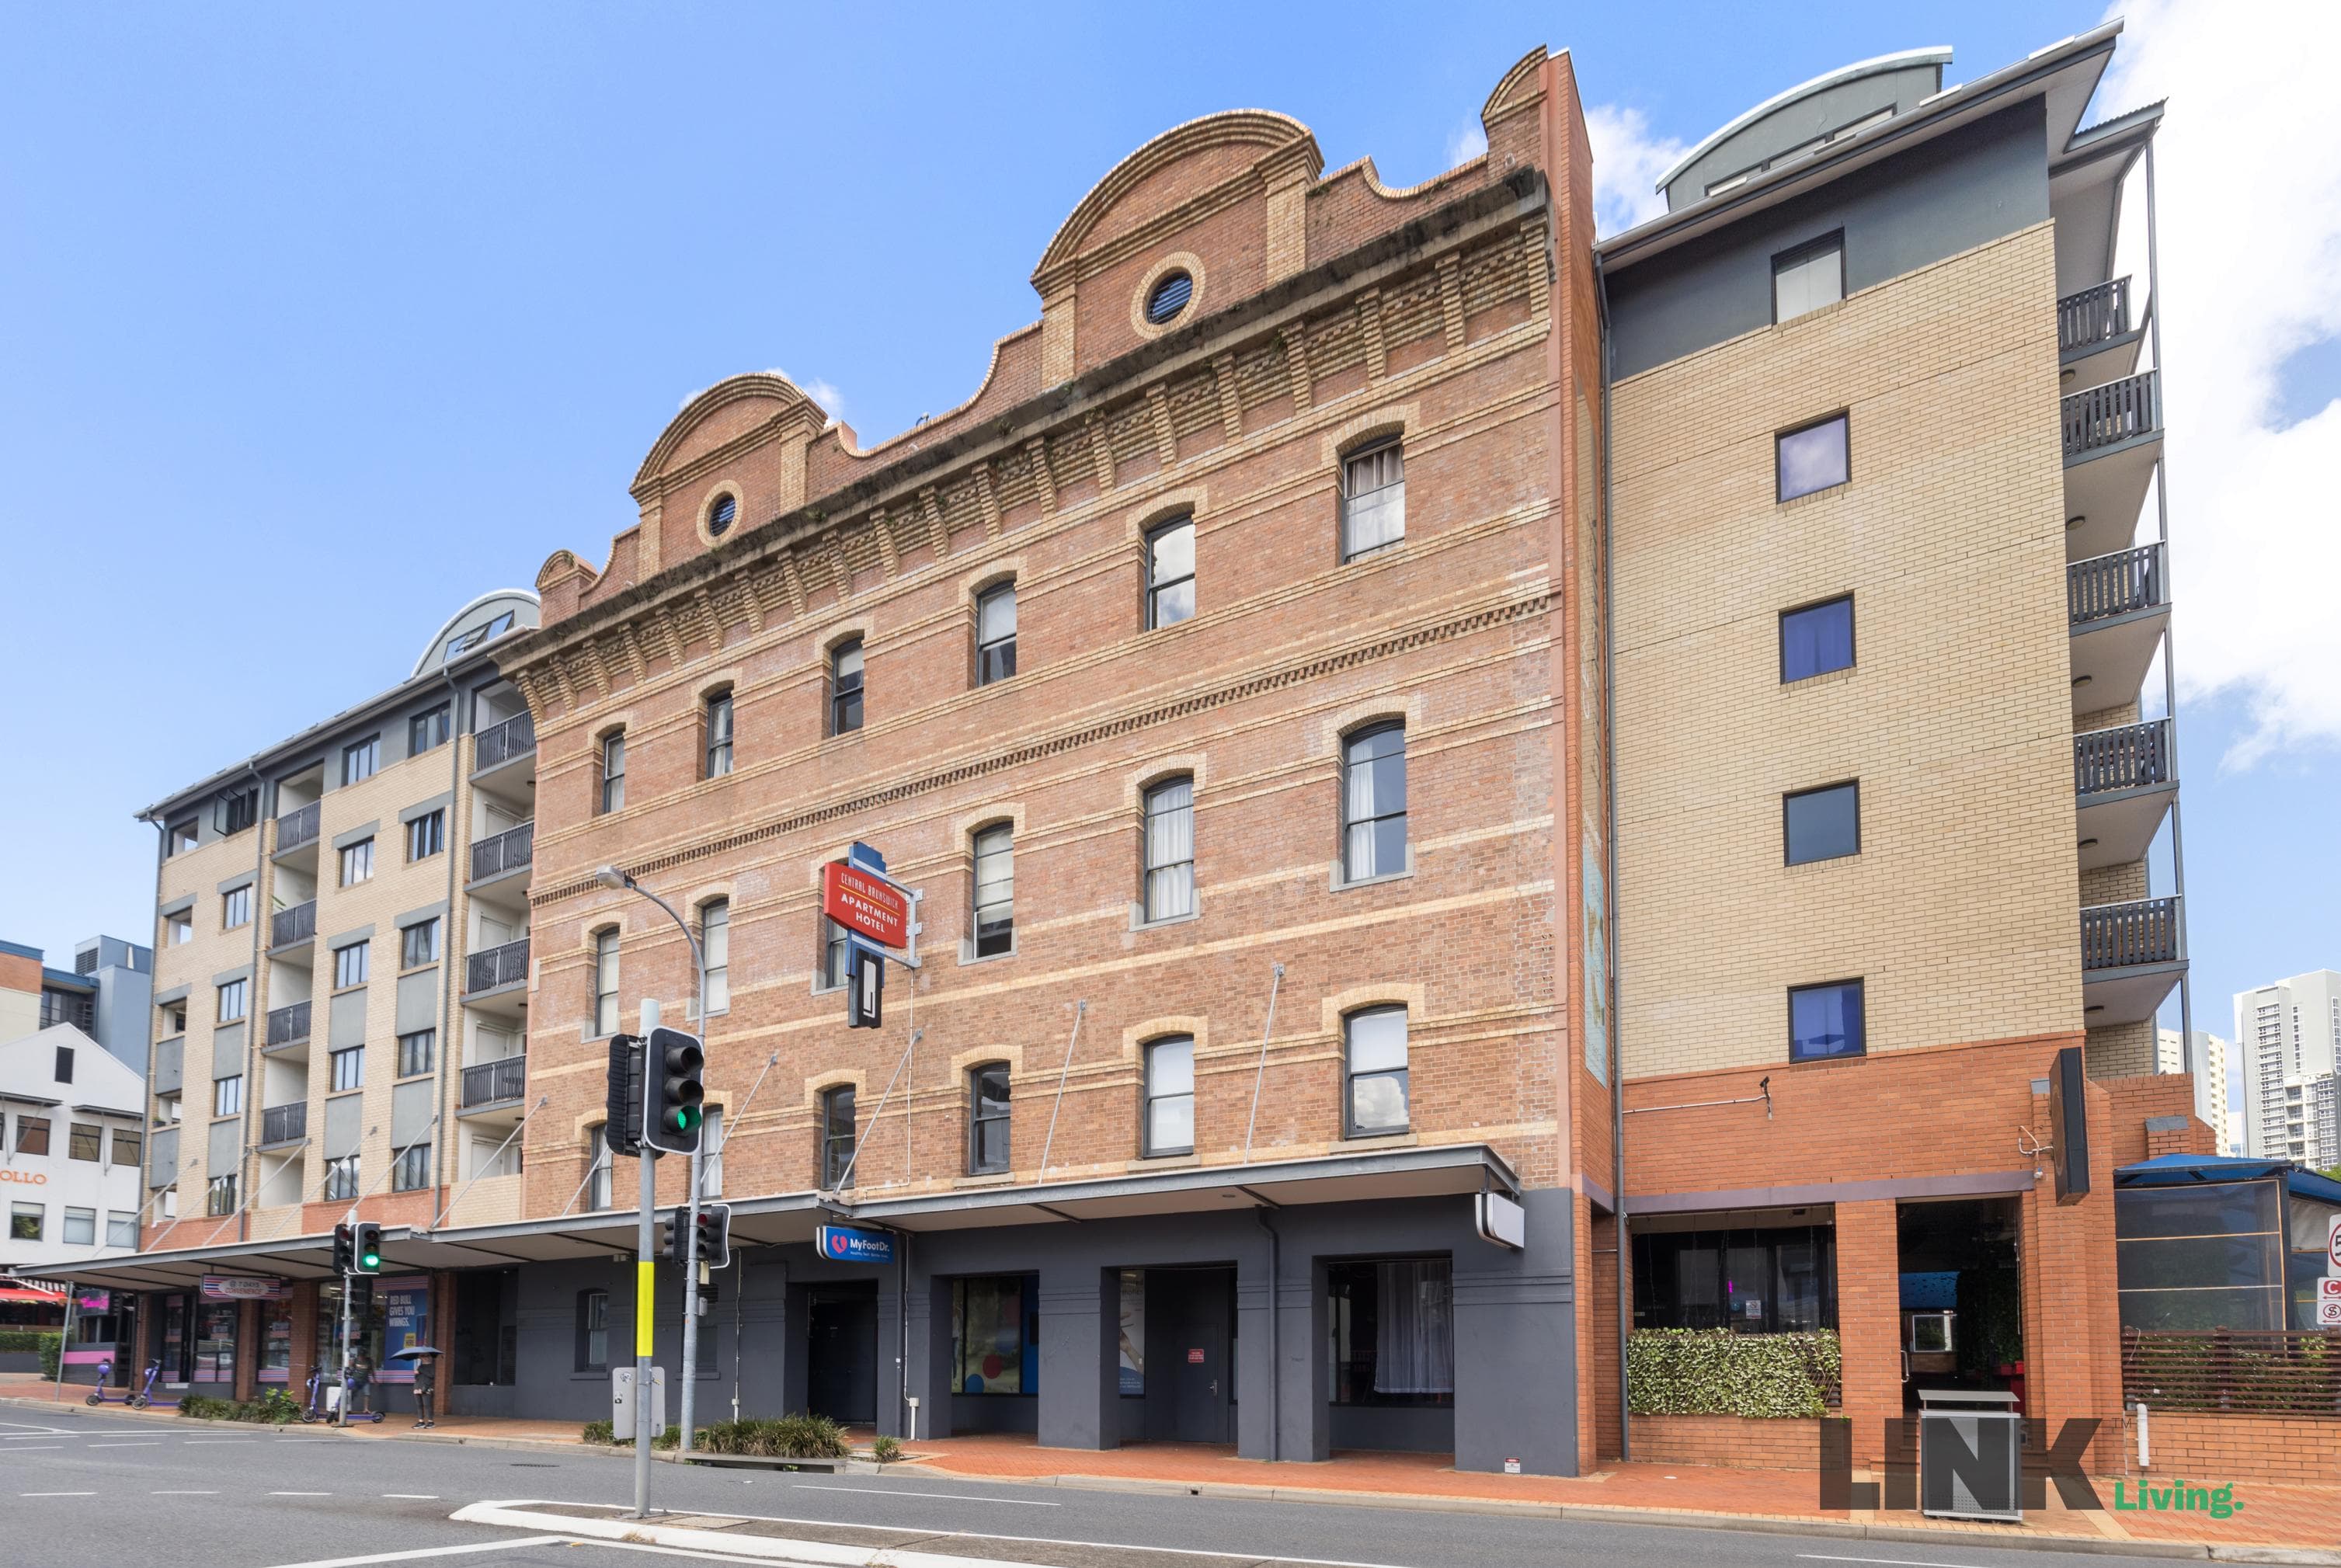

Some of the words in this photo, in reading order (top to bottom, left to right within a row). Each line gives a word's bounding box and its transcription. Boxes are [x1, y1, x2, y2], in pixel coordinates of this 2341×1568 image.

[841, 872, 866, 893] CENTRAL
[868, 885, 899, 909] BRUNSWICK
[840, 893, 898, 927] APARTMENT
[856, 912, 885, 933] HOTEL
[850, 1238, 890, 1252] MyFootDr.
[2327, 1281, 2339, 1294] C
[389, 1306, 404, 1316] GIVES
[404, 1306, 416, 1316] YOU
